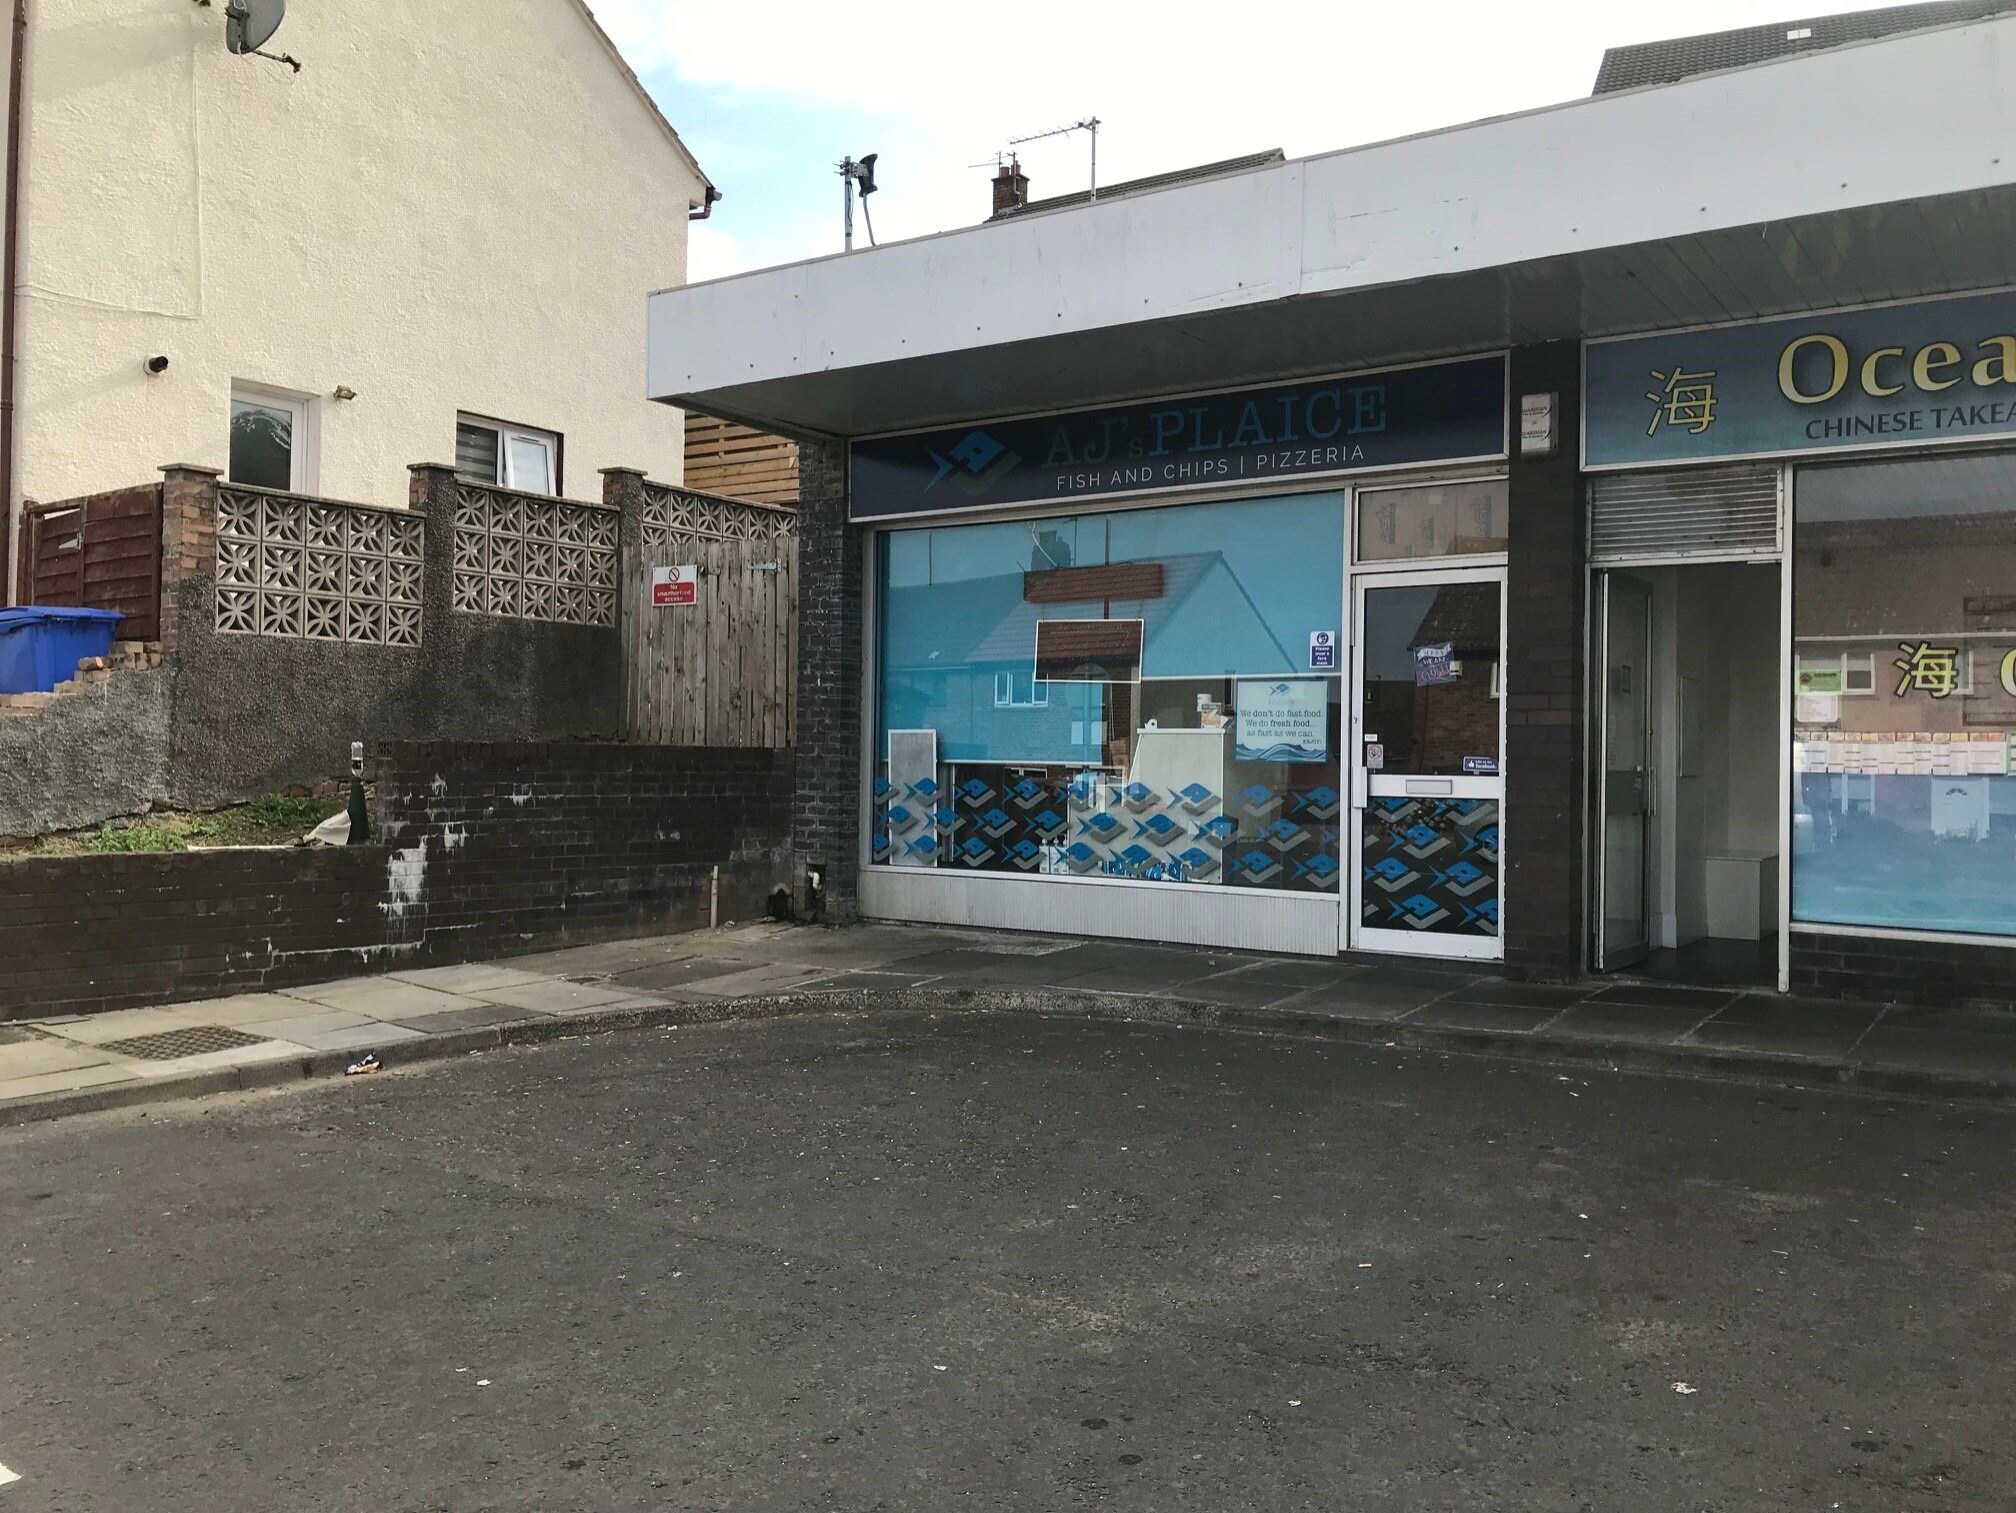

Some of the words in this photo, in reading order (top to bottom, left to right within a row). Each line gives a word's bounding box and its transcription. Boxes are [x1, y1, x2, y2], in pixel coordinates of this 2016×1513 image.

[1778, 334, 2016, 405] Ocea
[1149, 384, 1386, 457] PLAICE
[1645, 367, 1718, 437] 海
[1805, 411, 1923, 440] CHINESE
[1057, 472, 1100, 490] FISH
[1111, 467, 1153, 485] AND
[1164, 459, 1228, 479] CHIPS
[1257, 444, 1364, 470] PIZZERIA
[1893, 641, 1959, 698] 海
[1252, 709, 1273, 717] don't
[1275, 709, 1285, 717] do
[1287, 709, 1302, 717] fast
